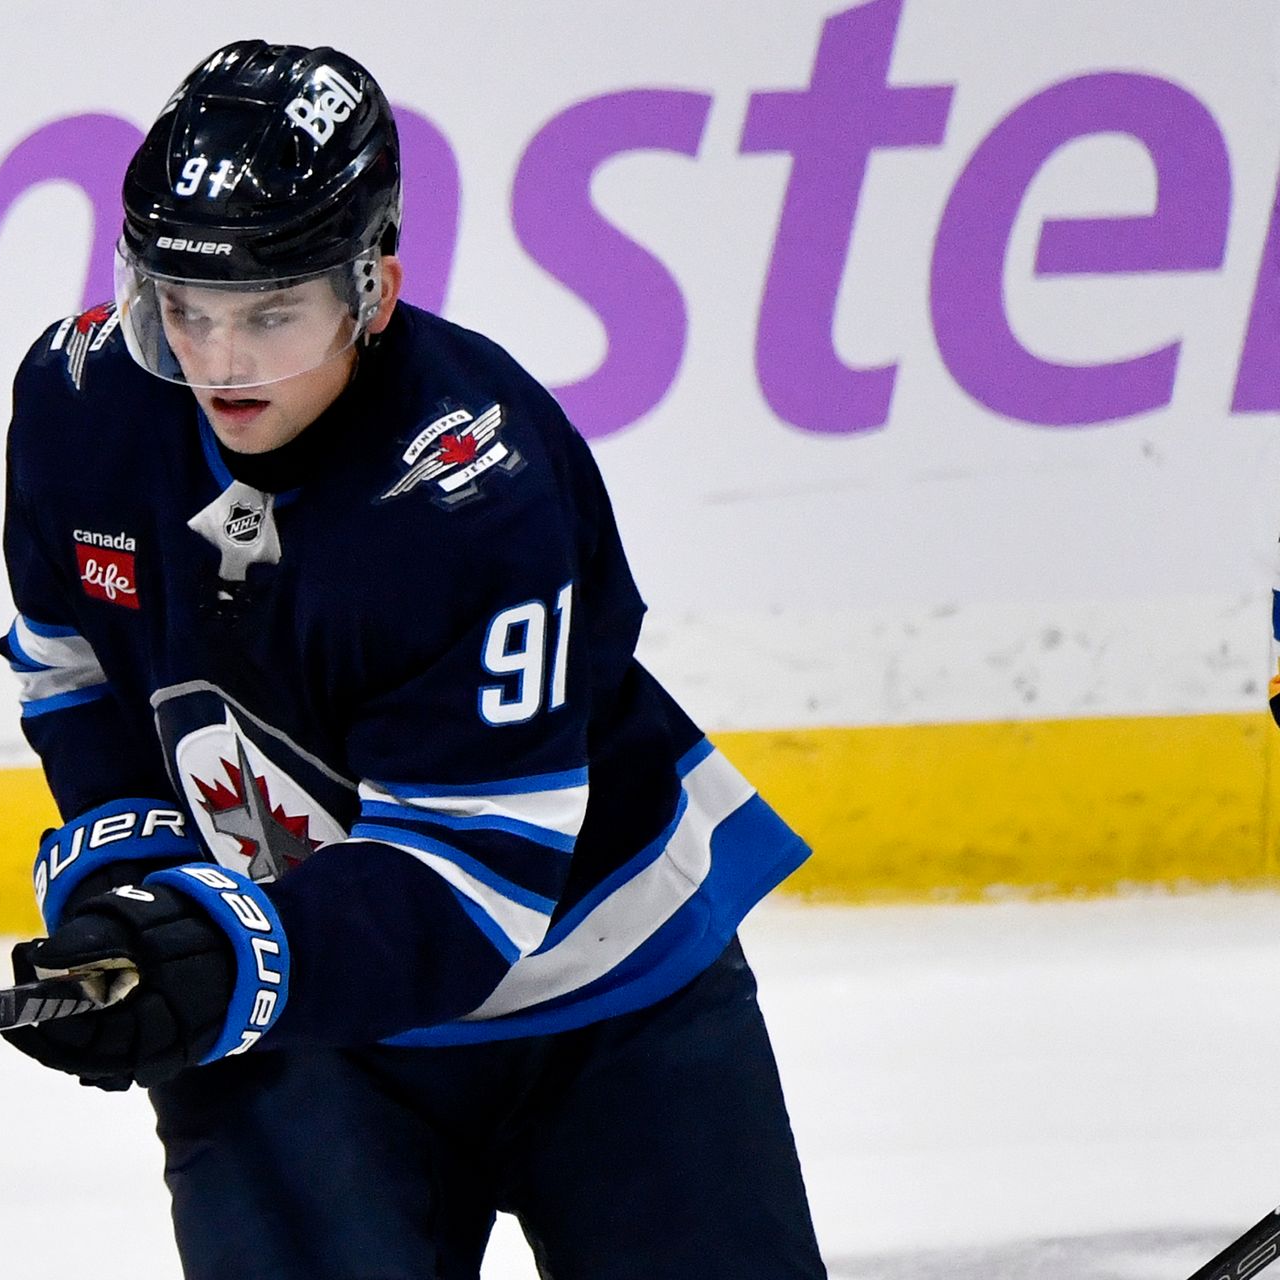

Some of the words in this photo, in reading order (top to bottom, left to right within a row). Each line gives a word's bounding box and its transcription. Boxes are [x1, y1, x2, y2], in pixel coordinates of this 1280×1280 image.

[284, 64, 363, 146] Bell
[175, 157, 232, 198] 91
[156, 236, 233, 256] BAUER
[408, 413, 466, 457] WINNIPEG
[463, 455, 494, 479] JETS
[72, 528, 137, 553] canada
[228, 513, 259, 534] NHL
[80, 558, 138, 601] life
[477, 579, 574, 728] 91
[180, 867, 282, 1058] BAUER
